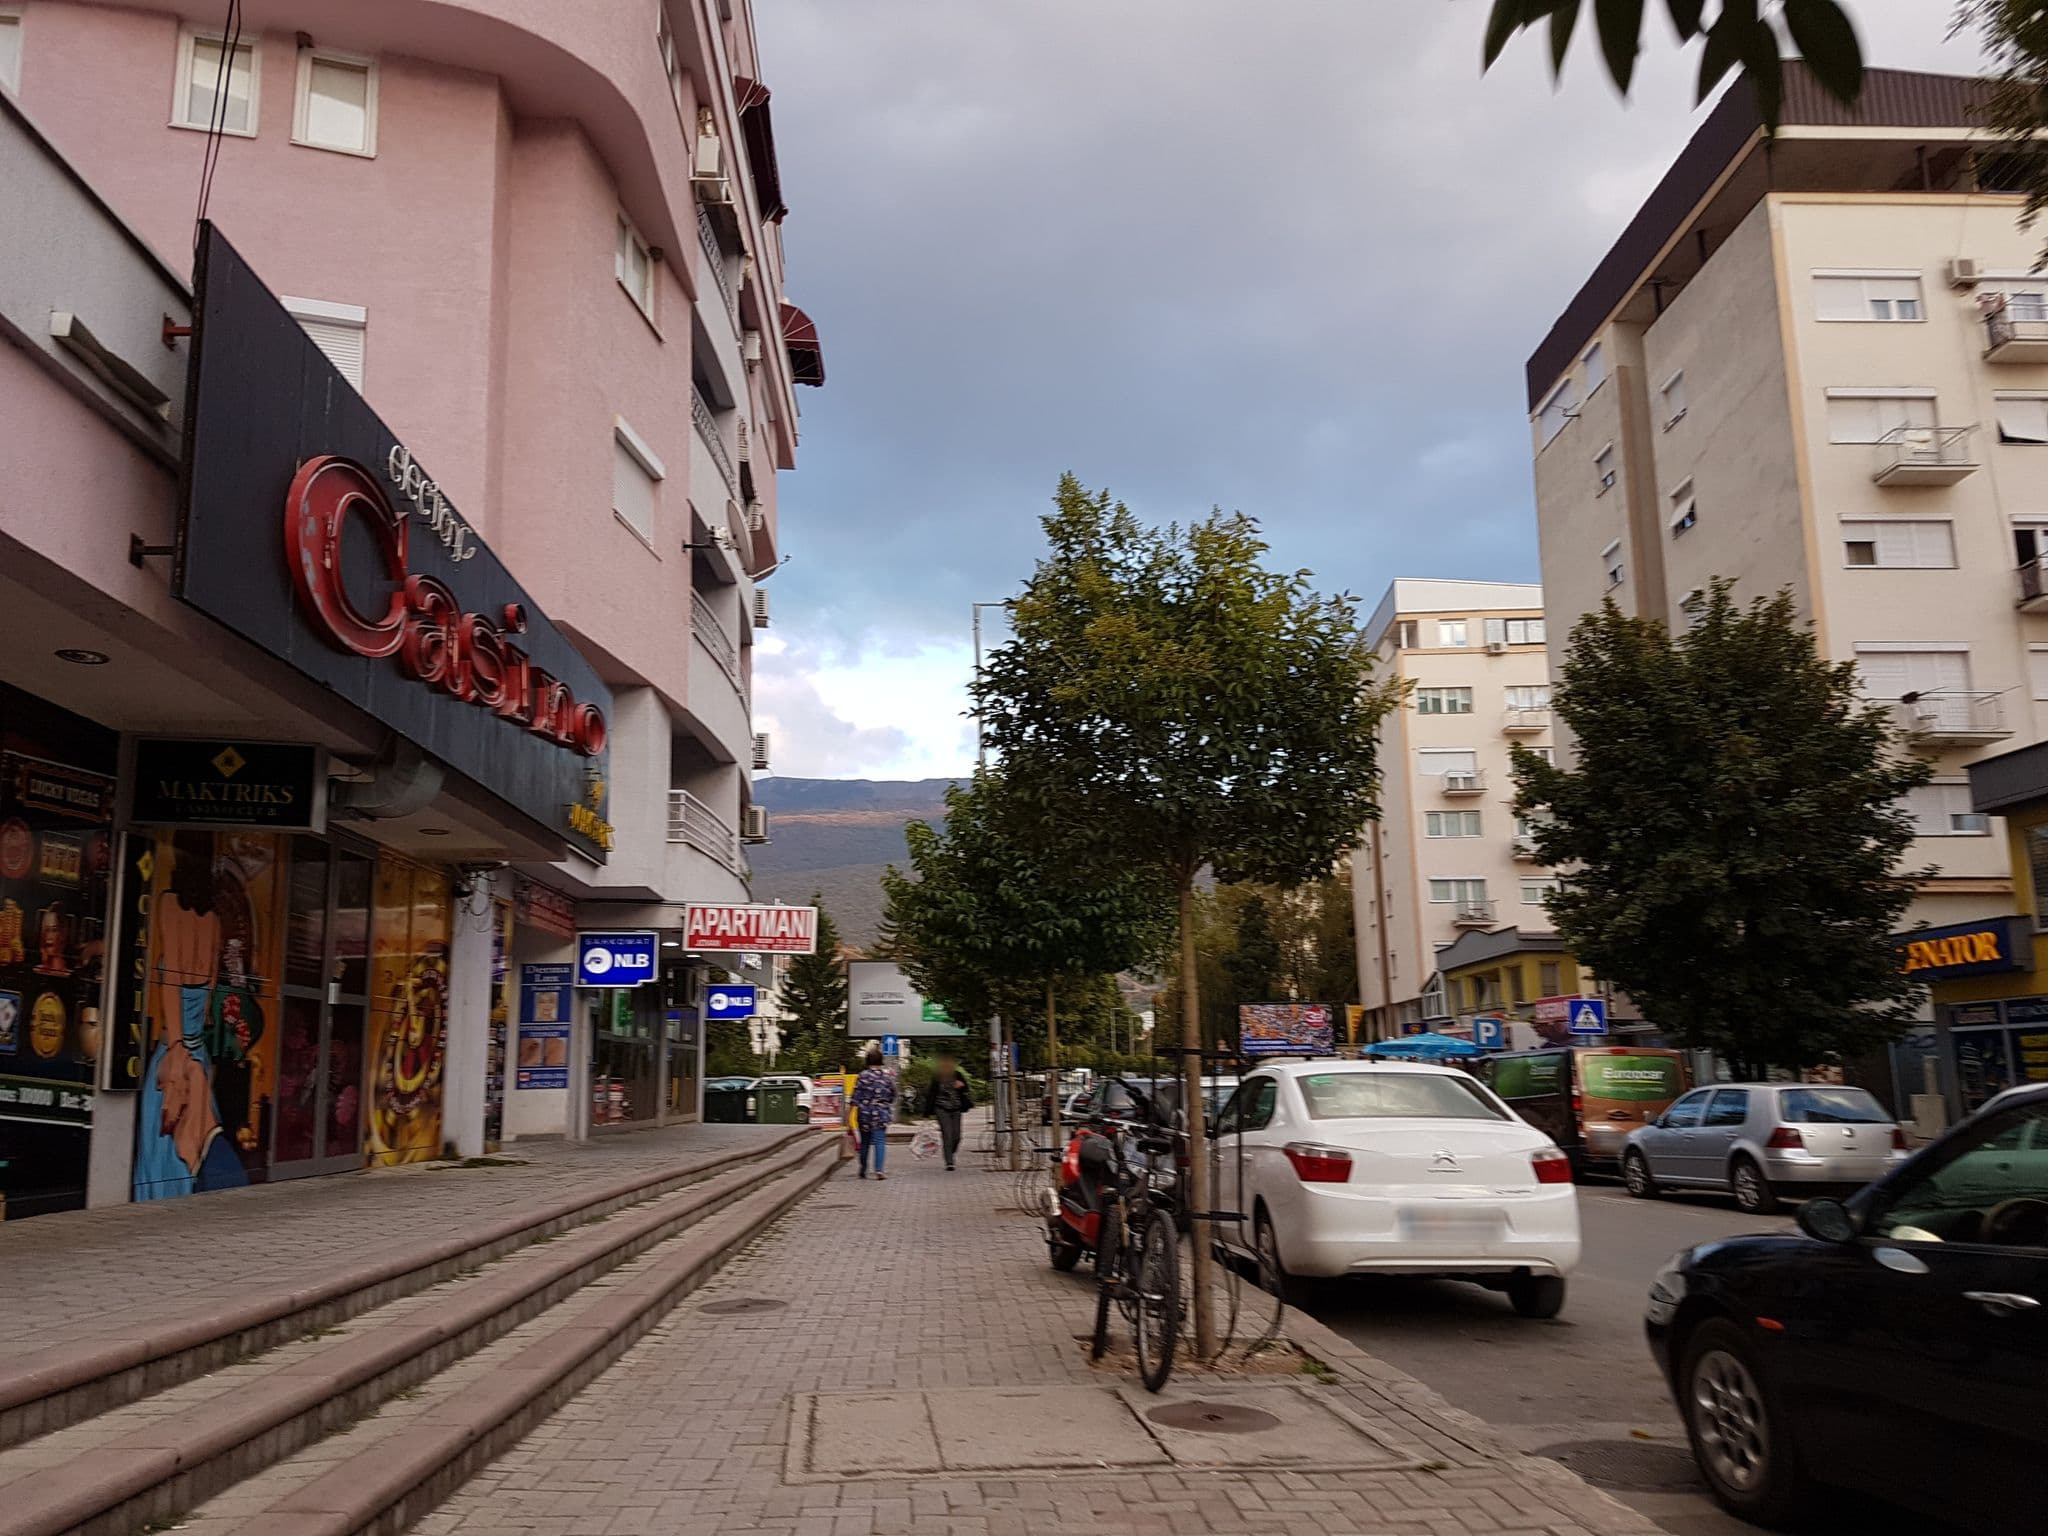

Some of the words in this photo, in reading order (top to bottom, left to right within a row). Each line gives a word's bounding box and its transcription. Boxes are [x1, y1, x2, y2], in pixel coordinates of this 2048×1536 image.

[284, 454, 609, 758] Casino
[157, 778, 296, 805] MAKTRIKS
[689, 907, 813, 938] APARTMANI
[613, 953, 650, 968] NLB
[126, 893, 150, 1079] CASINO
[727, 996, 753, 1007] NLB
[1478, 1022, 1498, 1045] P
